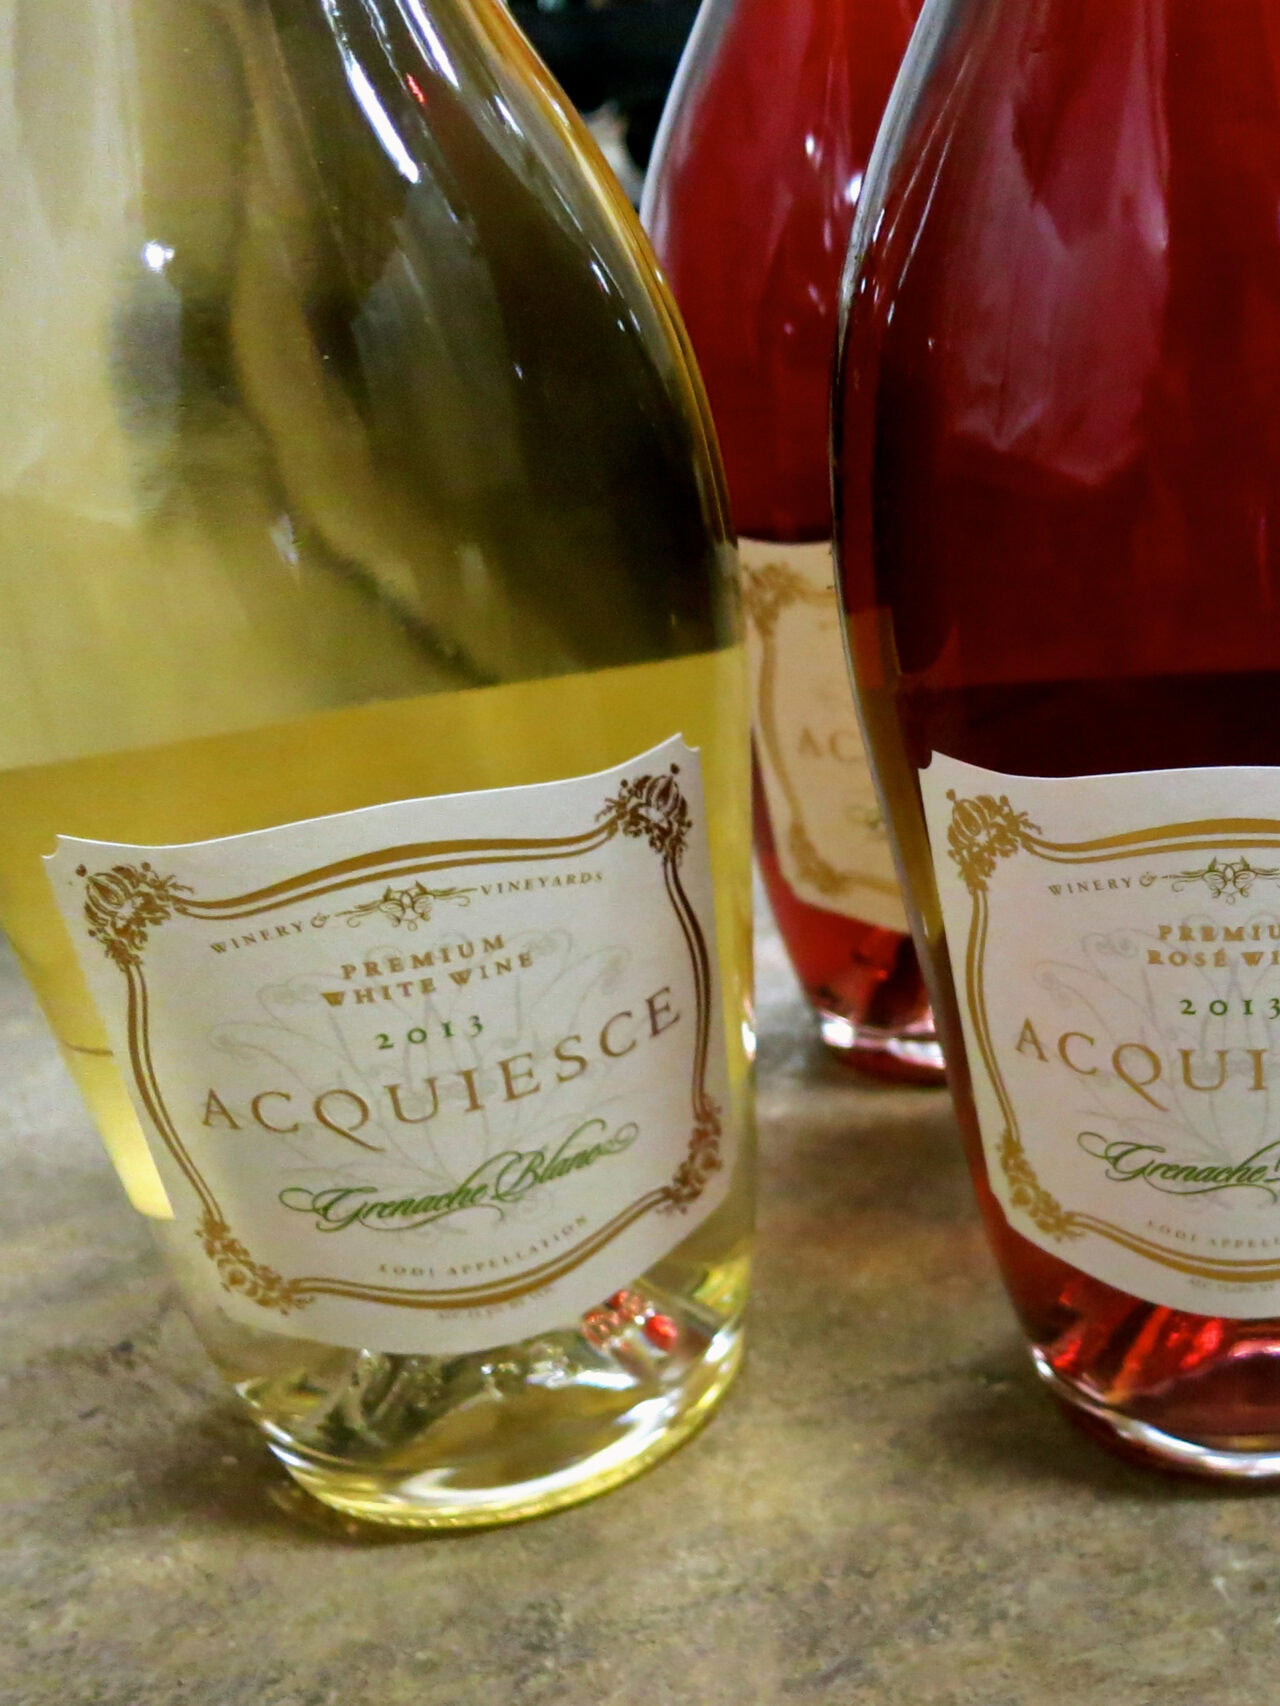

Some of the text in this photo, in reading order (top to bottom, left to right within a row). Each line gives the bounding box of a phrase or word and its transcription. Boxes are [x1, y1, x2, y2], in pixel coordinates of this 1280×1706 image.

[210, 920, 303, 953] WINERY
[479, 869, 604, 897] VINEYARDS
[1048, 877, 1134, 897] WINERY
[321, 950, 536, 1007] WHITE WINE
[341, 934, 506, 980] PREMIUM
[375, 1014, 485, 1050] 2013
[202, 985, 680, 1152] ACQUIESCE
[279, 1119, 639, 1232] Grenache Blanc
